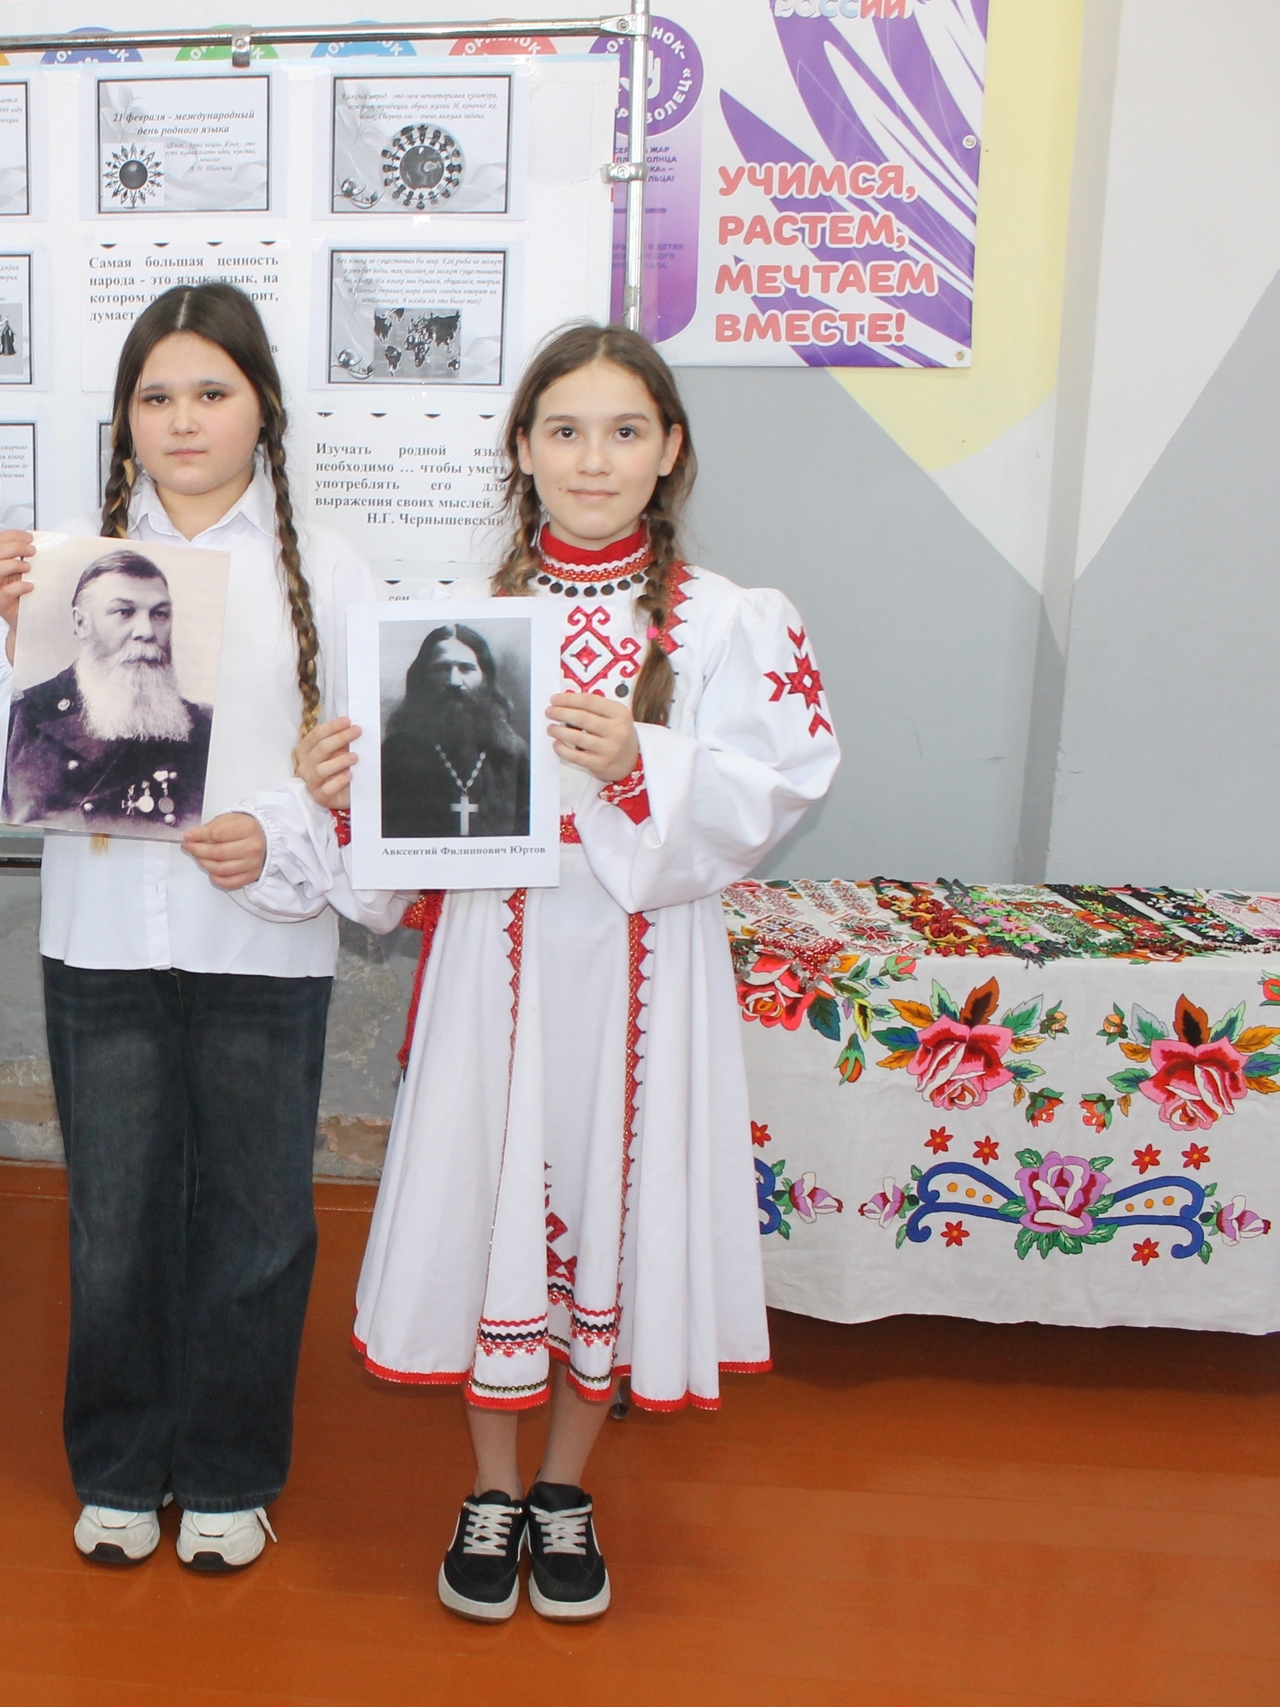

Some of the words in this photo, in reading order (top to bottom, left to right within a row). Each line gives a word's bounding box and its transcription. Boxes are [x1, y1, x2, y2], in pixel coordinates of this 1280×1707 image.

[113, 112, 122, 122] 21
[125, 112, 166, 124] февраля
[174, 110, 255, 122] международный
[137, 126, 159, 136] день
[160, 126, 199, 137] родного
[201, 126, 230, 134] языка
[650, 146, 670, 154] ЖАР
[719, 164, 917, 199] УЧИМСЯ,
[719, 214, 909, 249] РАСТЕМ,
[89, 257, 132, 269] Самая
[145, 256, 204, 268] большая
[217, 256, 279, 269] ценность
[89, 276, 135, 288] народа
[150, 276, 171, 285] это
[220, 275, 257, 286] язык,
[263, 274, 279, 284] на
[715, 262, 936, 295] МЕЧТАЕМ
[90, 293, 145, 306] котором
[715, 312, 906, 343] ВМЕСТЕ!
[316, 442, 372, 458] Изучать
[398, 444, 447, 459] родной
[315, 460, 395, 474] необходимо
[420, 462, 463, 474] чтобы
[467, 464, 508, 477] уметь
[315, 478, 400, 492] употреблять
[430, 482, 452, 491] его
[482, 483, 507, 492] для
[315, 497, 393, 509] выражения
[396, 499, 435, 508] своих
[438, 497, 495, 509] мыслей.
[366, 512, 395, 524] Н.Г.
[399, 513, 504, 528] Чернышевский
[381, 847, 438, 857] Авксентий
[440, 845, 507, 857] Филиппович
[510, 845, 546, 858] Юртов
